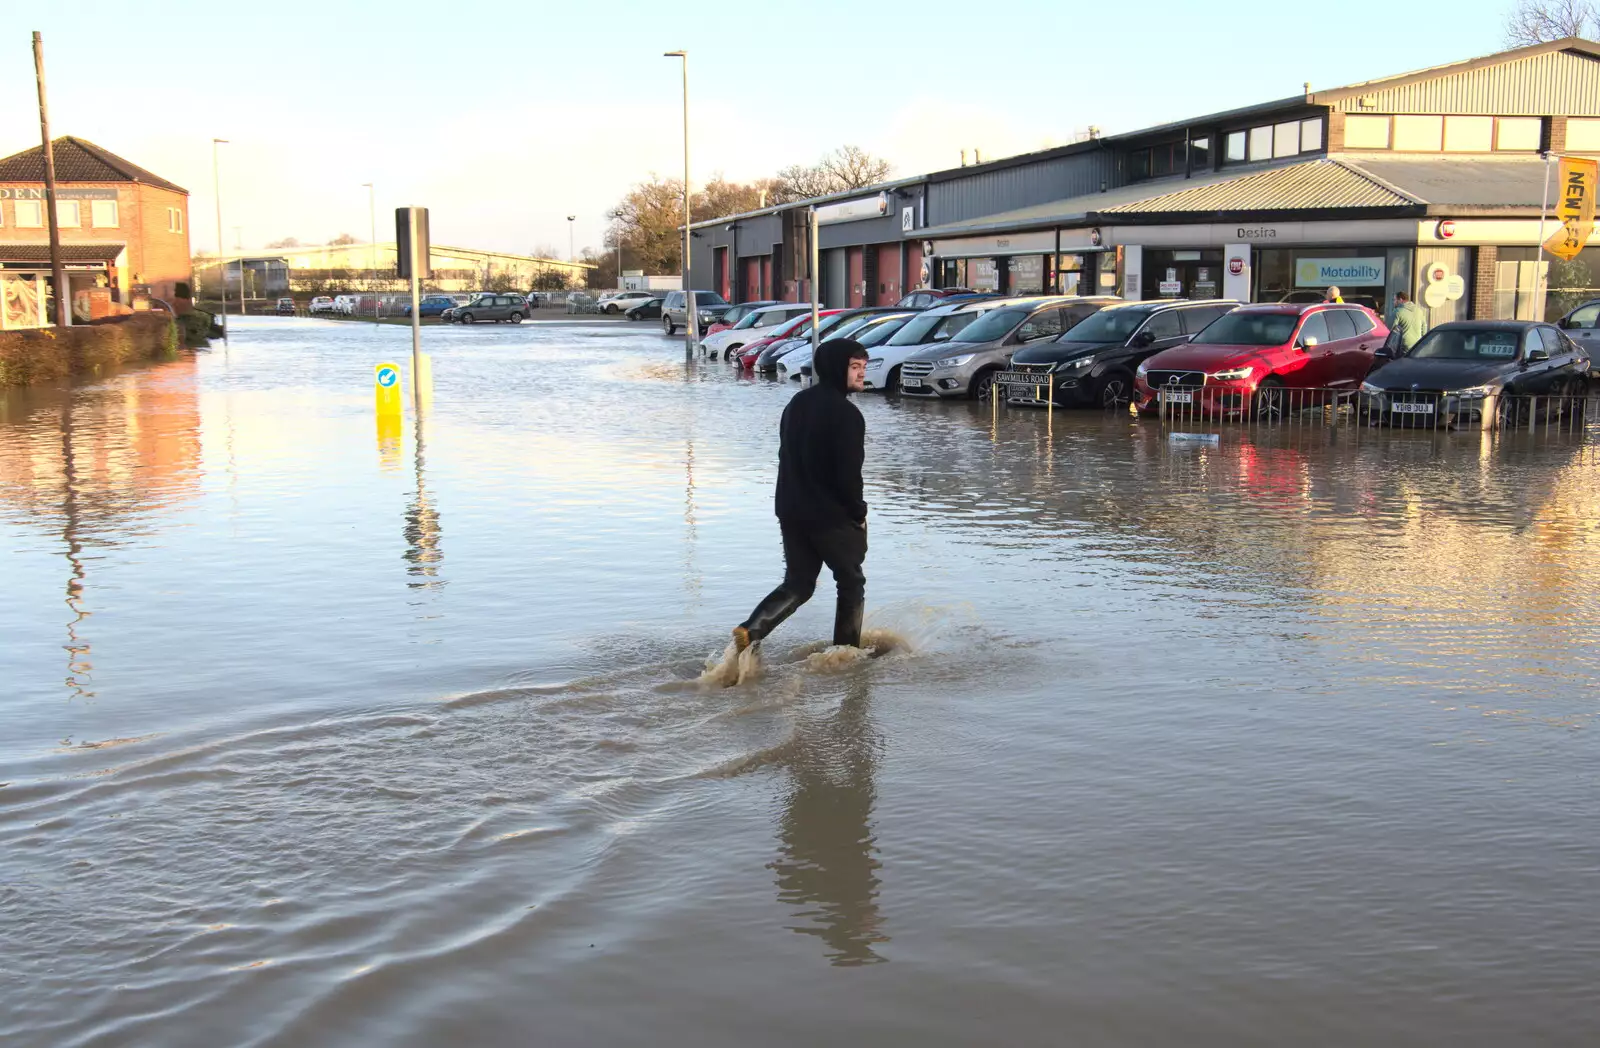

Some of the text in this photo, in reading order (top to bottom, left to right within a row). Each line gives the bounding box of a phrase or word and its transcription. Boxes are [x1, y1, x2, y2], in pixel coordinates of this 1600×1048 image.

[1564, 171, 1585, 210] NEW
[1237, 227, 1277, 239] Desira
[1321, 265, 1380, 280] Motability
[997, 373, 1049, 384] SAWMILLS ROAD
